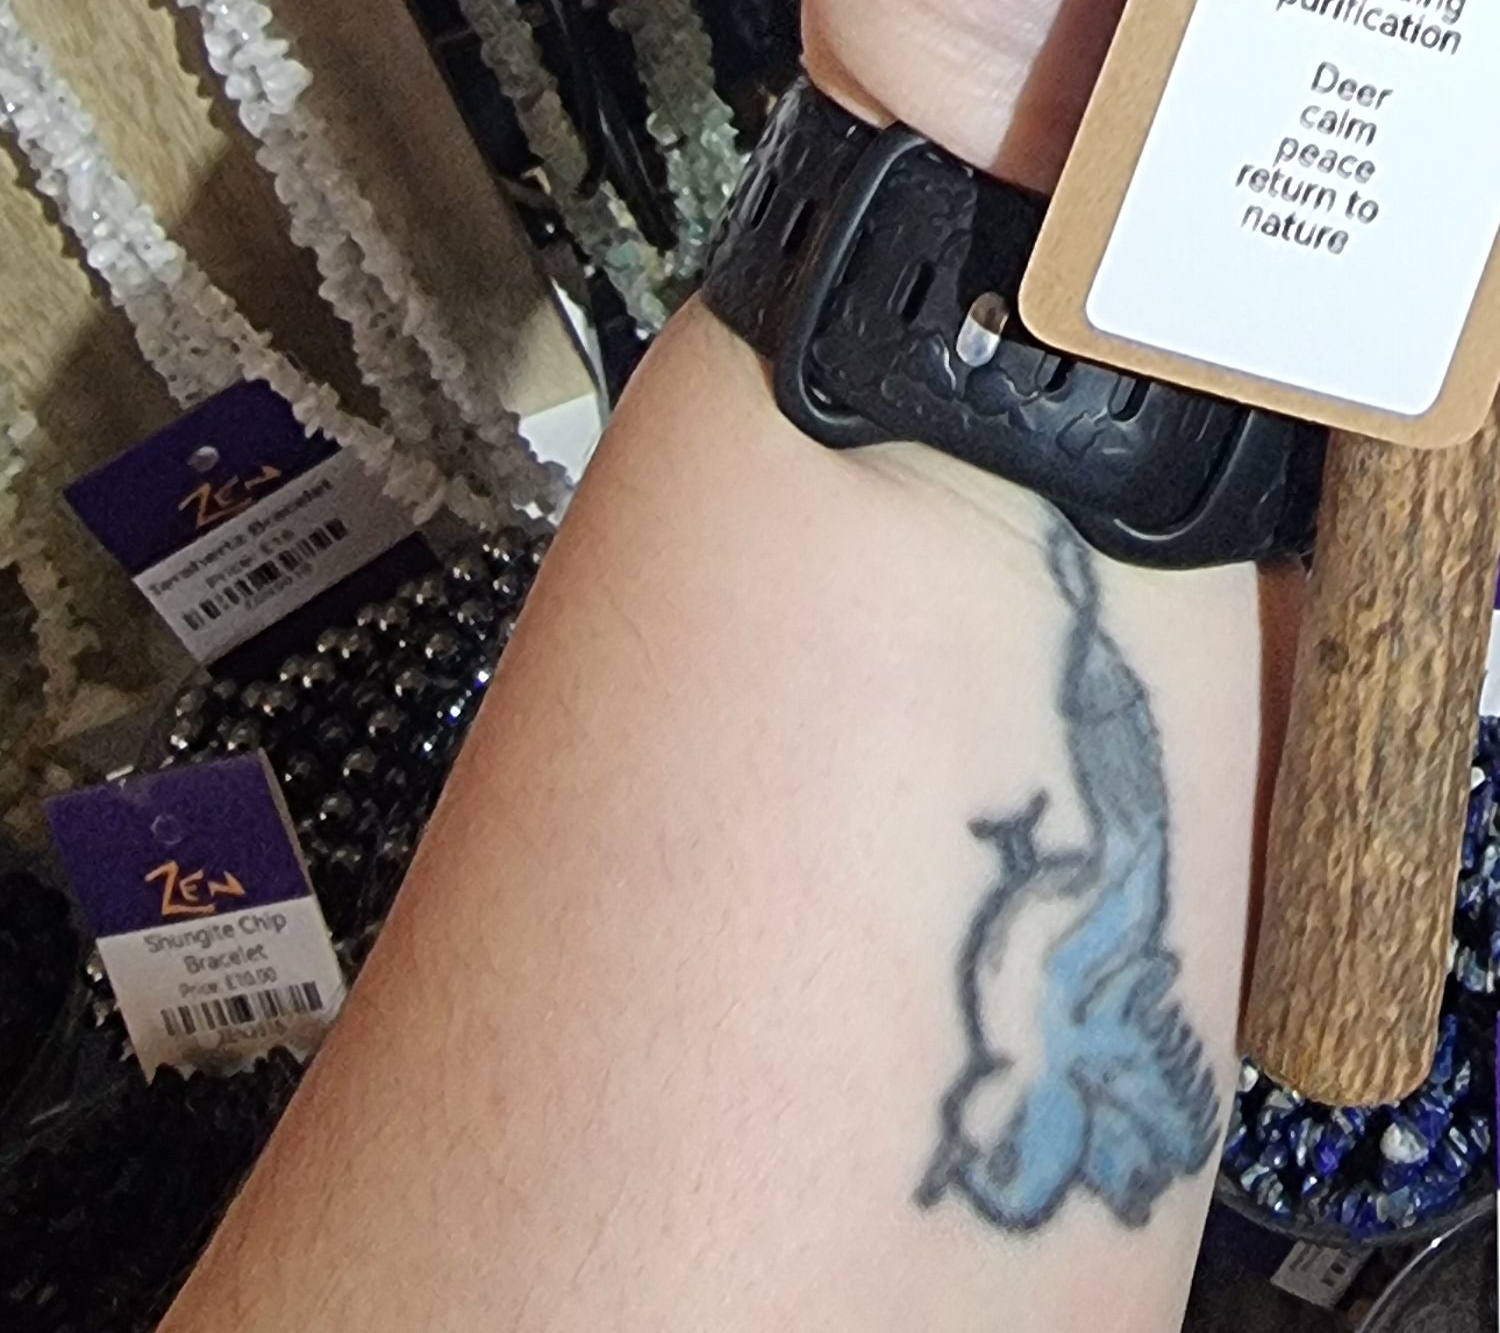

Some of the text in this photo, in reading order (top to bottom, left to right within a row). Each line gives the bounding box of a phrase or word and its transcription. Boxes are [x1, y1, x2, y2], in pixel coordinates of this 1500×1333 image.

[1310, 61, 1394, 111] Deer
[1299, 104, 1377, 147] calm
[1272, 136, 1376, 184] peace
[1234, 164, 1379, 225] return to
[1240, 204, 1349, 255] nature
[178, 465, 281, 528] ZEN
[248, 478, 333, 536] Bracelet
[145, 860, 246, 916] ZEN
[143, 913, 288, 953] Shungite Chip
[184, 943, 269, 974] Bracelet
